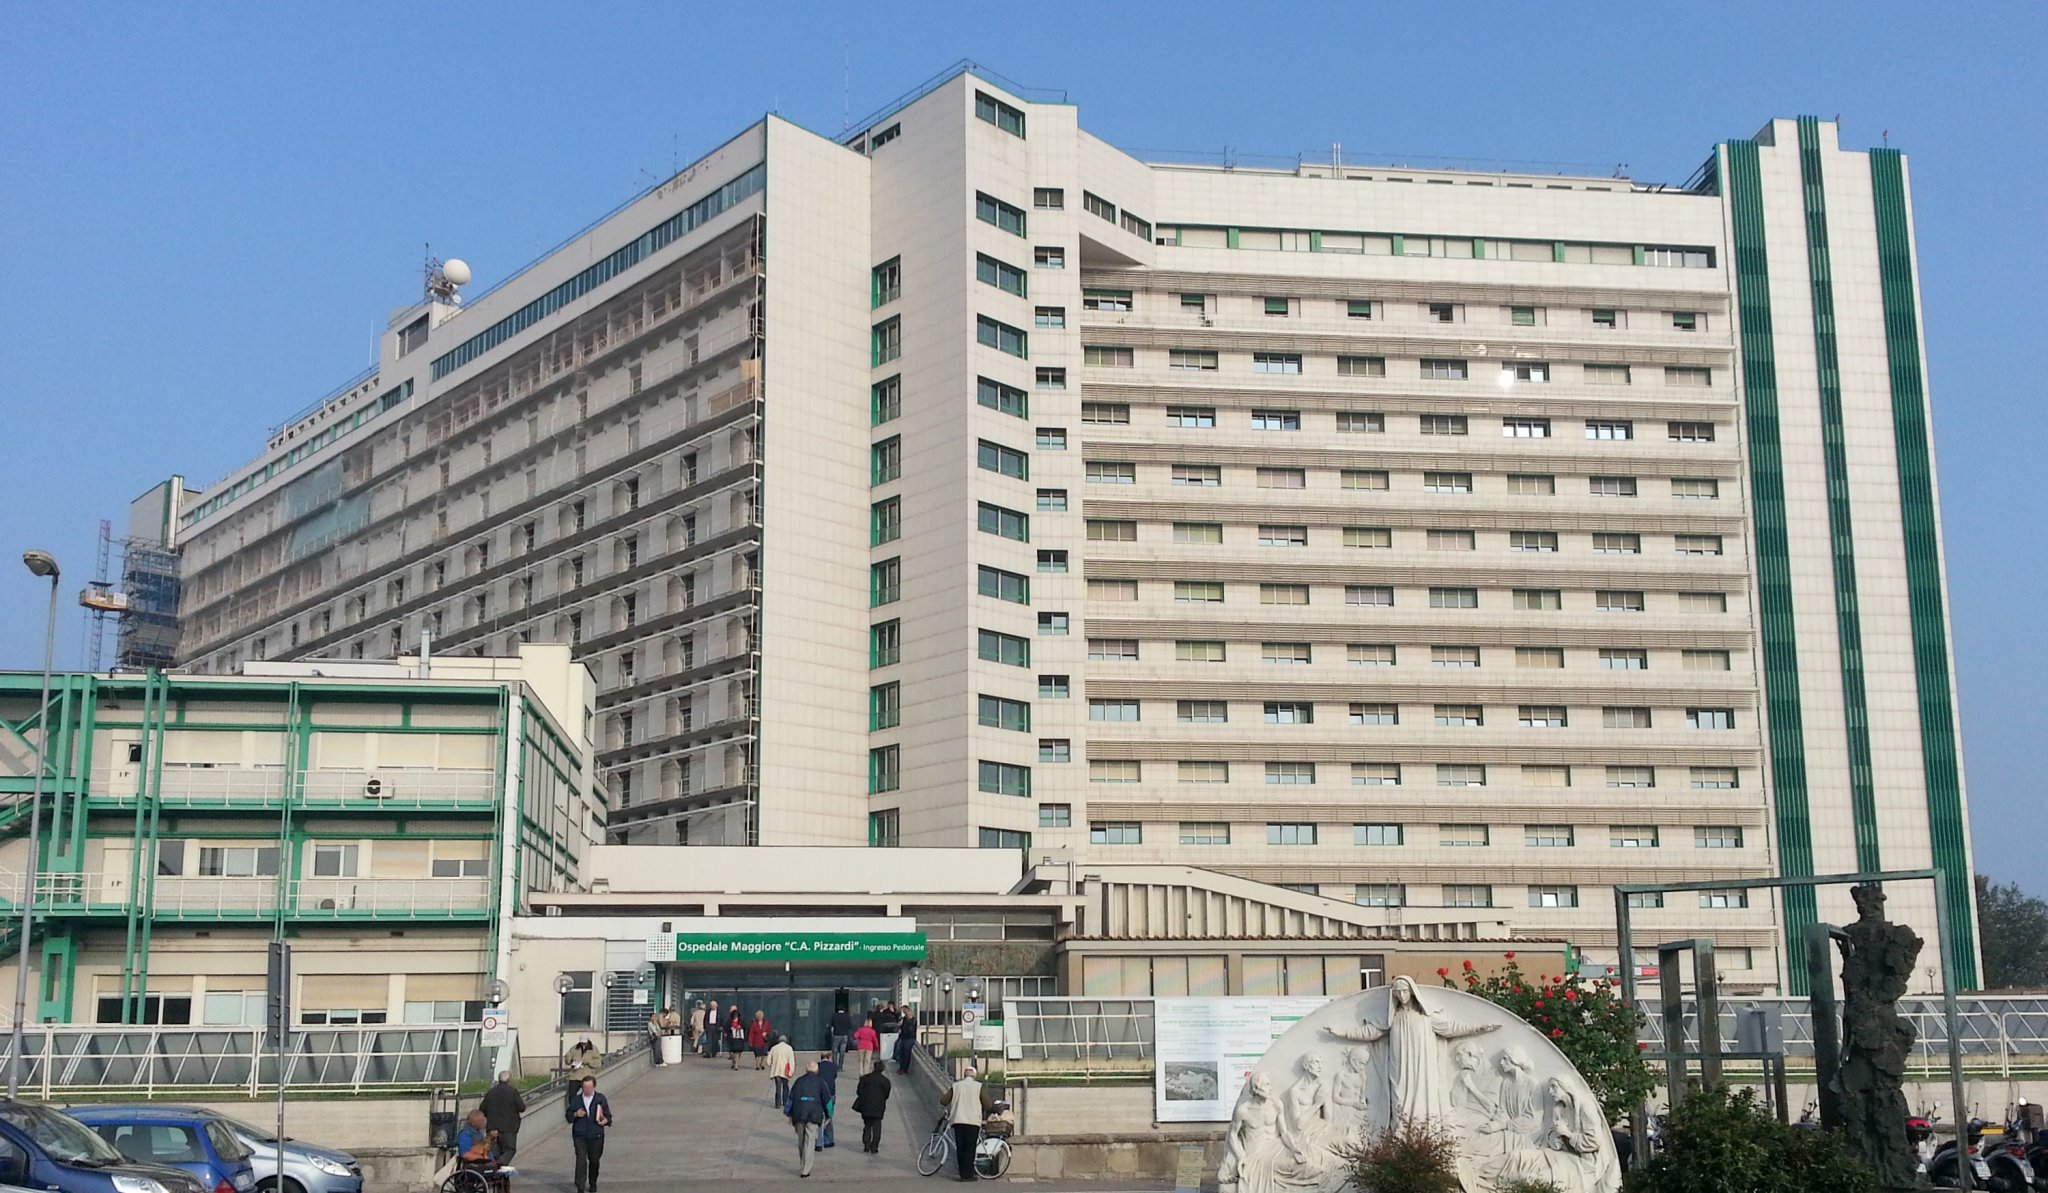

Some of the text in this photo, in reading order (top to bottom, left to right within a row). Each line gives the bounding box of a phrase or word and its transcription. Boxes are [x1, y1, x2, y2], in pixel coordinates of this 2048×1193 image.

[678, 941, 728, 953] Ospedale
[731, 941, 782, 953] Maggiore
[863, 944, 891, 952] Ingresso
[893, 943, 925, 951] Pedonale
